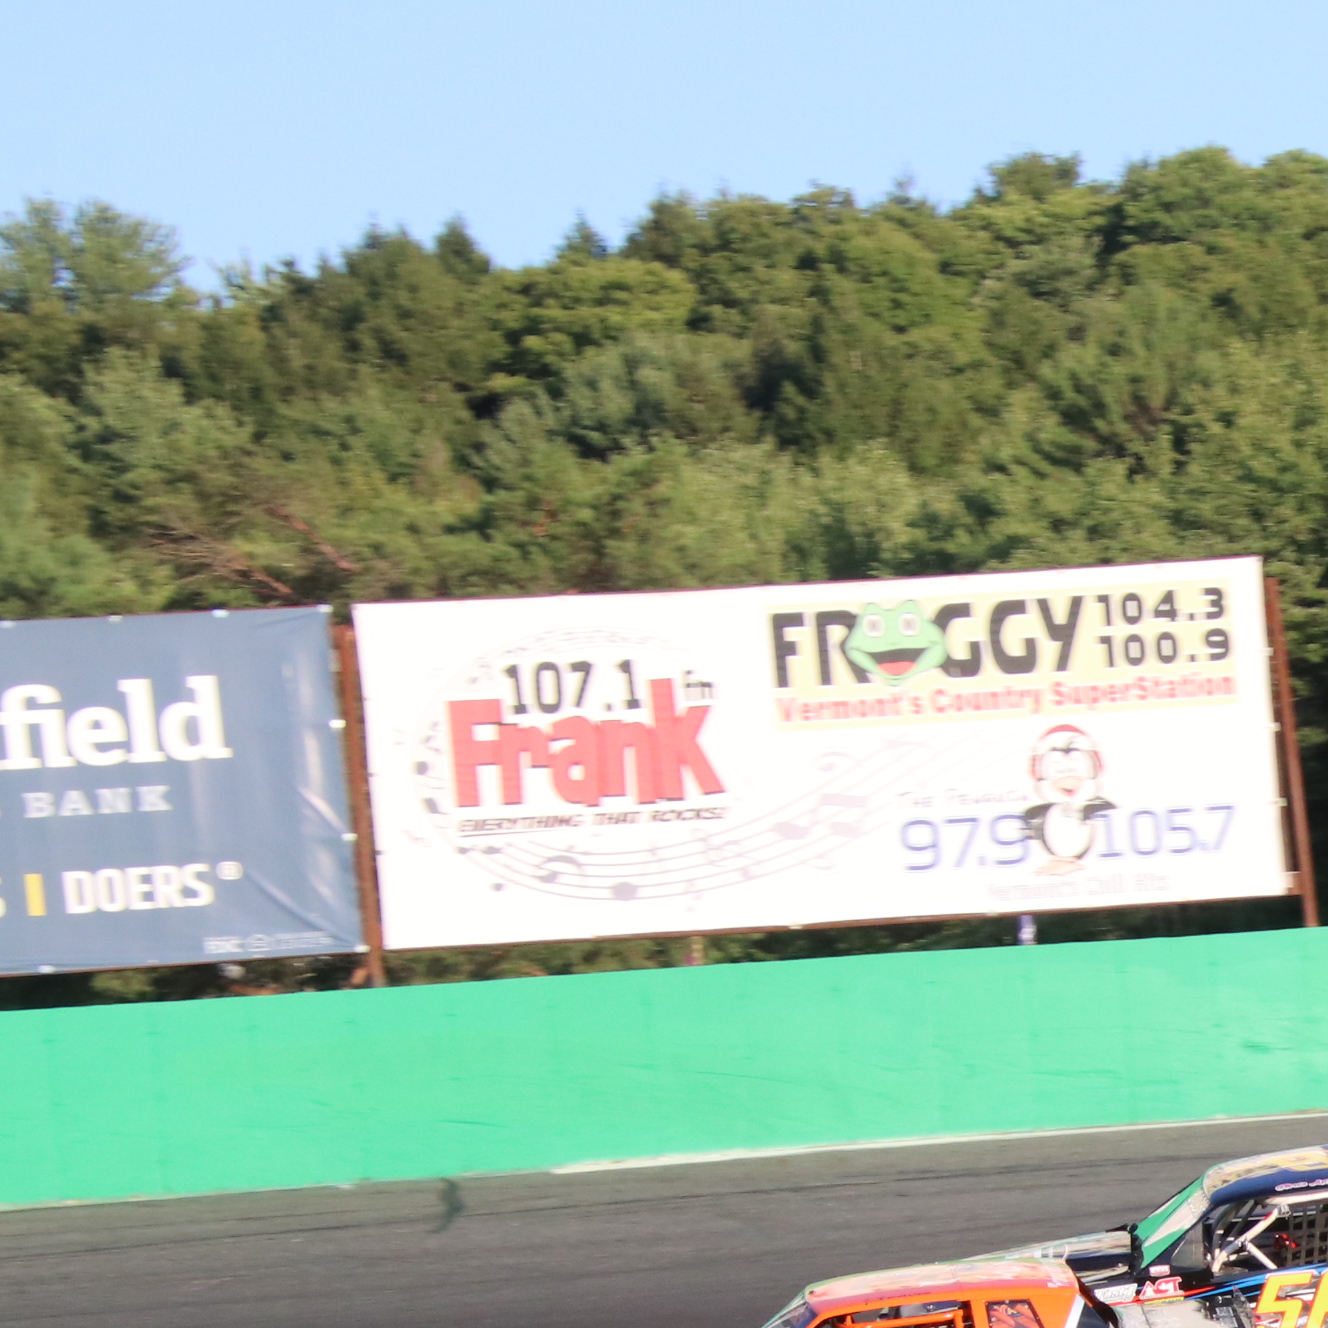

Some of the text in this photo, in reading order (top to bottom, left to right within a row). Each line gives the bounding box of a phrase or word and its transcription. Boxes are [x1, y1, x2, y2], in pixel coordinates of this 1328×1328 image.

[1096, 586, 1226, 627] 104.3
[1097, 628, 1230, 668] 100.9
[504, 659, 641, 715] 107.1
[776, 671, 1236, 722] Vermont's Country SuperStation
[446, 677, 726, 807] Frank
[21, 785, 173, 818] BANK
[897, 812, 1032, 873] 97.9
[1089, 805, 1236, 859] 105.7
[61, 862, 216, 915] DOERS
[1139, 1276, 1183, 1299] ACT
